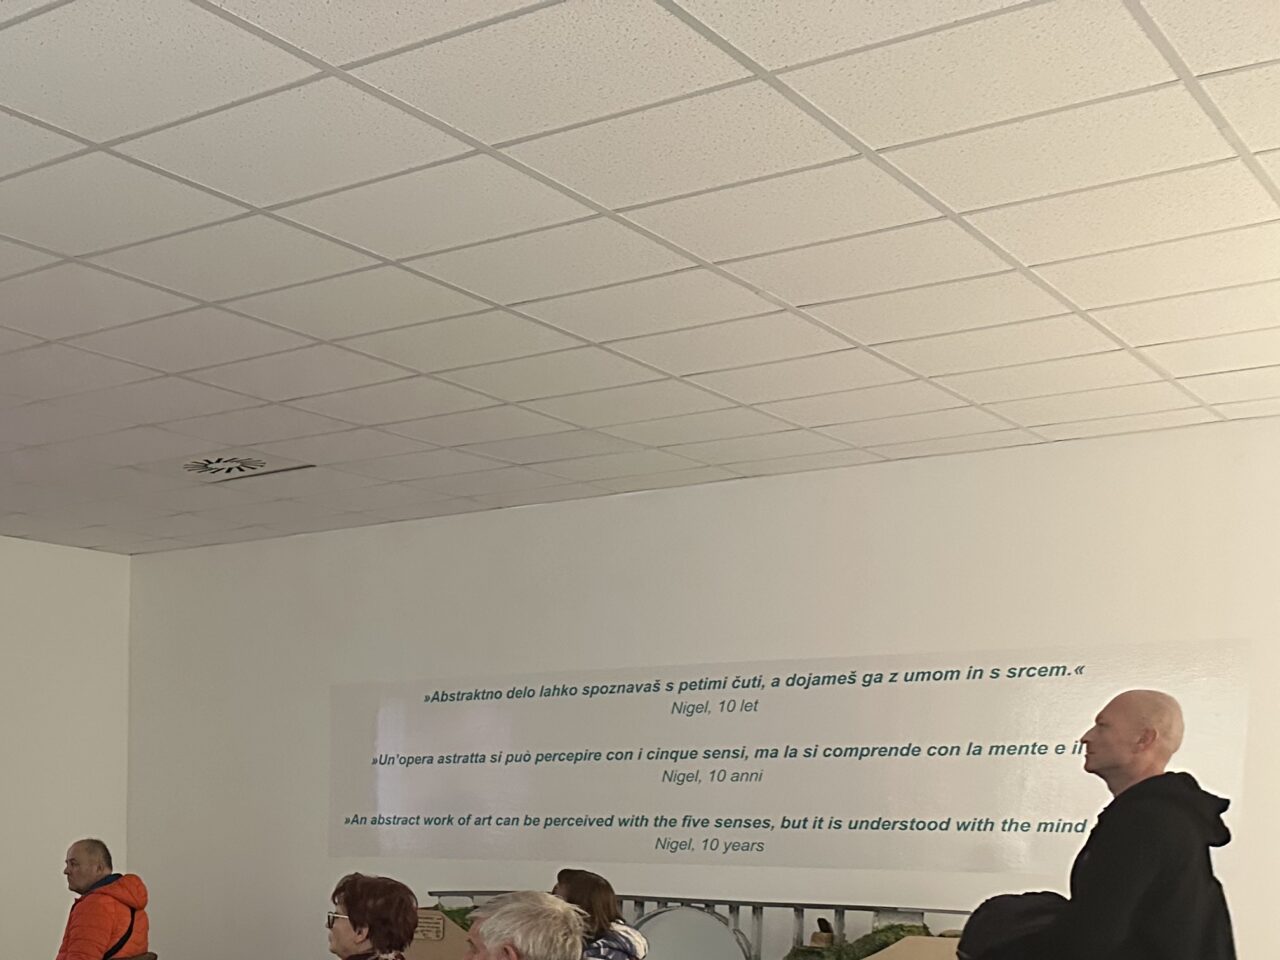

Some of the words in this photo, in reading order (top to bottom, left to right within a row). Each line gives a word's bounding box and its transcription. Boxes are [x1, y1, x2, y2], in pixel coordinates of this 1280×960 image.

[424, 689, 503, 703] »Abstraktno
[506, 686, 535, 699] delo
[539, 684, 578, 697] lahko
[582, 679, 660, 698] spoznavaš
[665, 681, 674, 692] s
[678, 676, 728, 694] petimi
[732, 675, 765, 690] čuti,
[771, 677, 780, 688] a
[786, 671, 857, 689] dojameš
[862, 673, 883, 687] ga
[888, 671, 899, 682] z
[904, 669, 961, 682] umom
[966, 666, 984, 680] in
[989, 668, 1000, 679] s
[1006, 665, 1085, 679] srcem.«
[671, 700, 711, 717] Nigel,
[719, 699, 736, 713] 10
[740, 699, 759, 712] let
[438, 752, 486, 764] astratta
[490, 751, 503, 763] si
[505, 749, 531, 766] può
[535, 749, 602, 765] percepire
[606, 750, 633, 762] con
[638, 748, 643, 760] i
[647, 748, 698, 762] cinque
[702, 746, 748, 760] sensi,
[754, 748, 779, 759] ma
[784, 745, 798, 759] la
[803, 745, 819, 758] si
[823, 743, 921, 760] comprende
[927, 745, 961, 757] con
[966, 742, 982, 756] la
[988, 742, 1048, 755] mente
[1055, 744, 1066, 755] e
[662, 770, 701, 785] Nigel,
[709, 769, 726, 782] 10
[730, 769, 764, 782] anni
[344, 814, 367, 826] »An
[371, 814, 420, 826] abstract
[424, 814, 454, 826] work
[458, 814, 472, 826] of
[474, 815, 492, 826] art
[496, 816, 519, 827] can
[524, 814, 540, 827] be
[544, 815, 613, 830] perceived
[618, 815, 649, 828] with
[654, 815, 677, 828] the
[682, 815, 710, 828] five
[714, 817, 774, 831] senses,
[780, 816, 808, 830] but
[812, 816, 824, 829] it
[828, 817, 842, 830] is
[848, 817, 951, 831] understood
[956, 818, 995, 832] with
[1001, 818, 1031, 832] the
[1036, 818, 1088, 833] mind
[655, 837, 694, 853] Nigel,
[702, 838, 719, 851] 10
[722, 840, 765, 854] years
